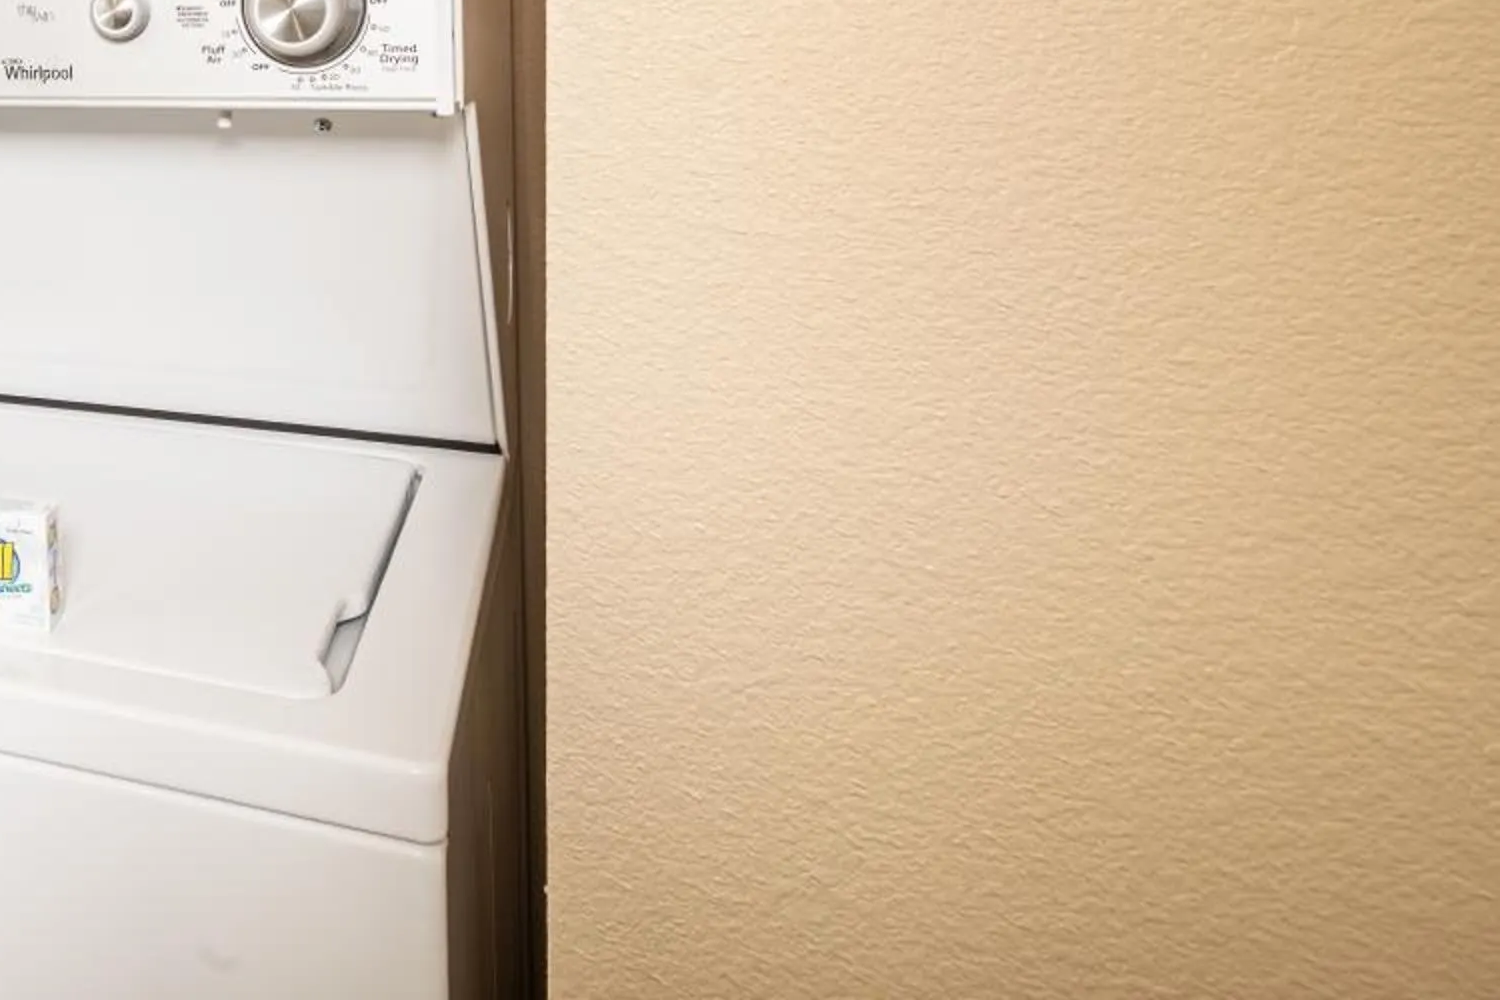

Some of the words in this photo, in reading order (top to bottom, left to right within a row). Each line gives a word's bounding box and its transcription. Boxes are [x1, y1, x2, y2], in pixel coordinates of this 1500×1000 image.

[383, 43, 417, 54] Timed
[379, 53, 419, 65] Drying
[3, 64, 74, 84] Whirlpool
